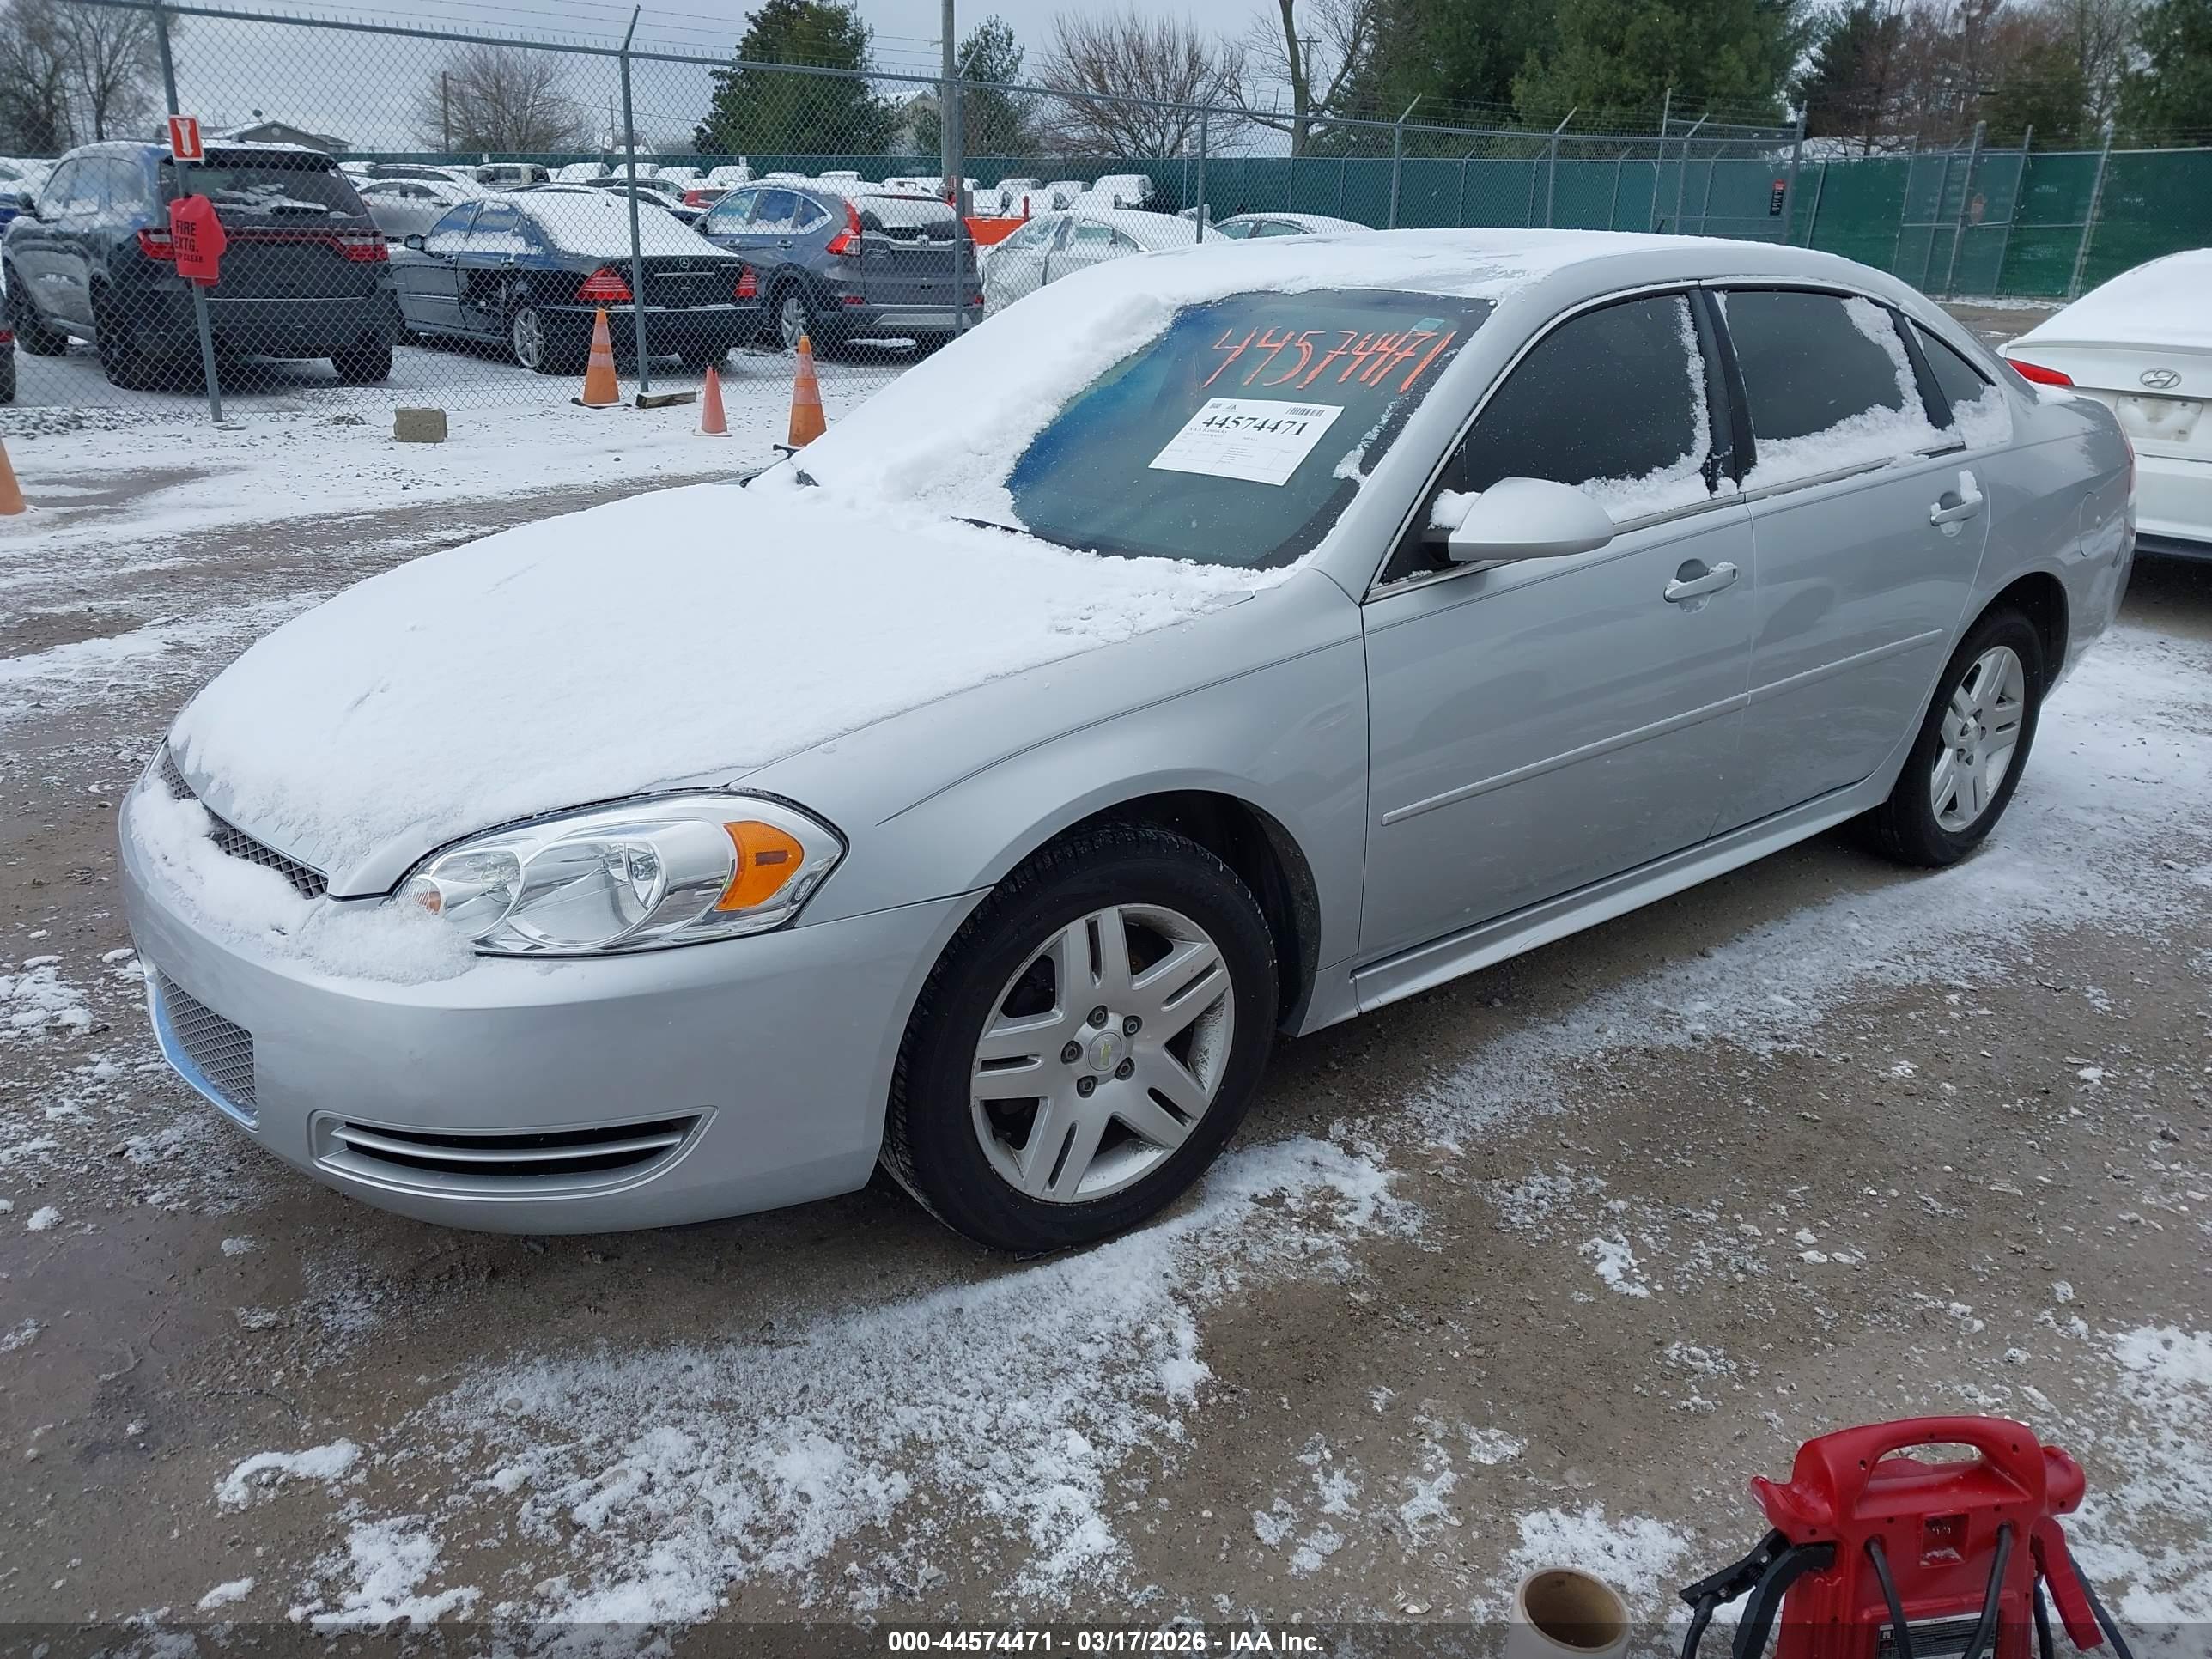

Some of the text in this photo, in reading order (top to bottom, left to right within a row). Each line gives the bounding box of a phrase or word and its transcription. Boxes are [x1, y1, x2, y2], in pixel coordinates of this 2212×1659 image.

[176, 220, 197, 236] FIRE
[174, 236, 199, 252] EXTG.
[1202, 326, 1458, 394] 44574471
[1202, 415, 1310, 436] 44574471
